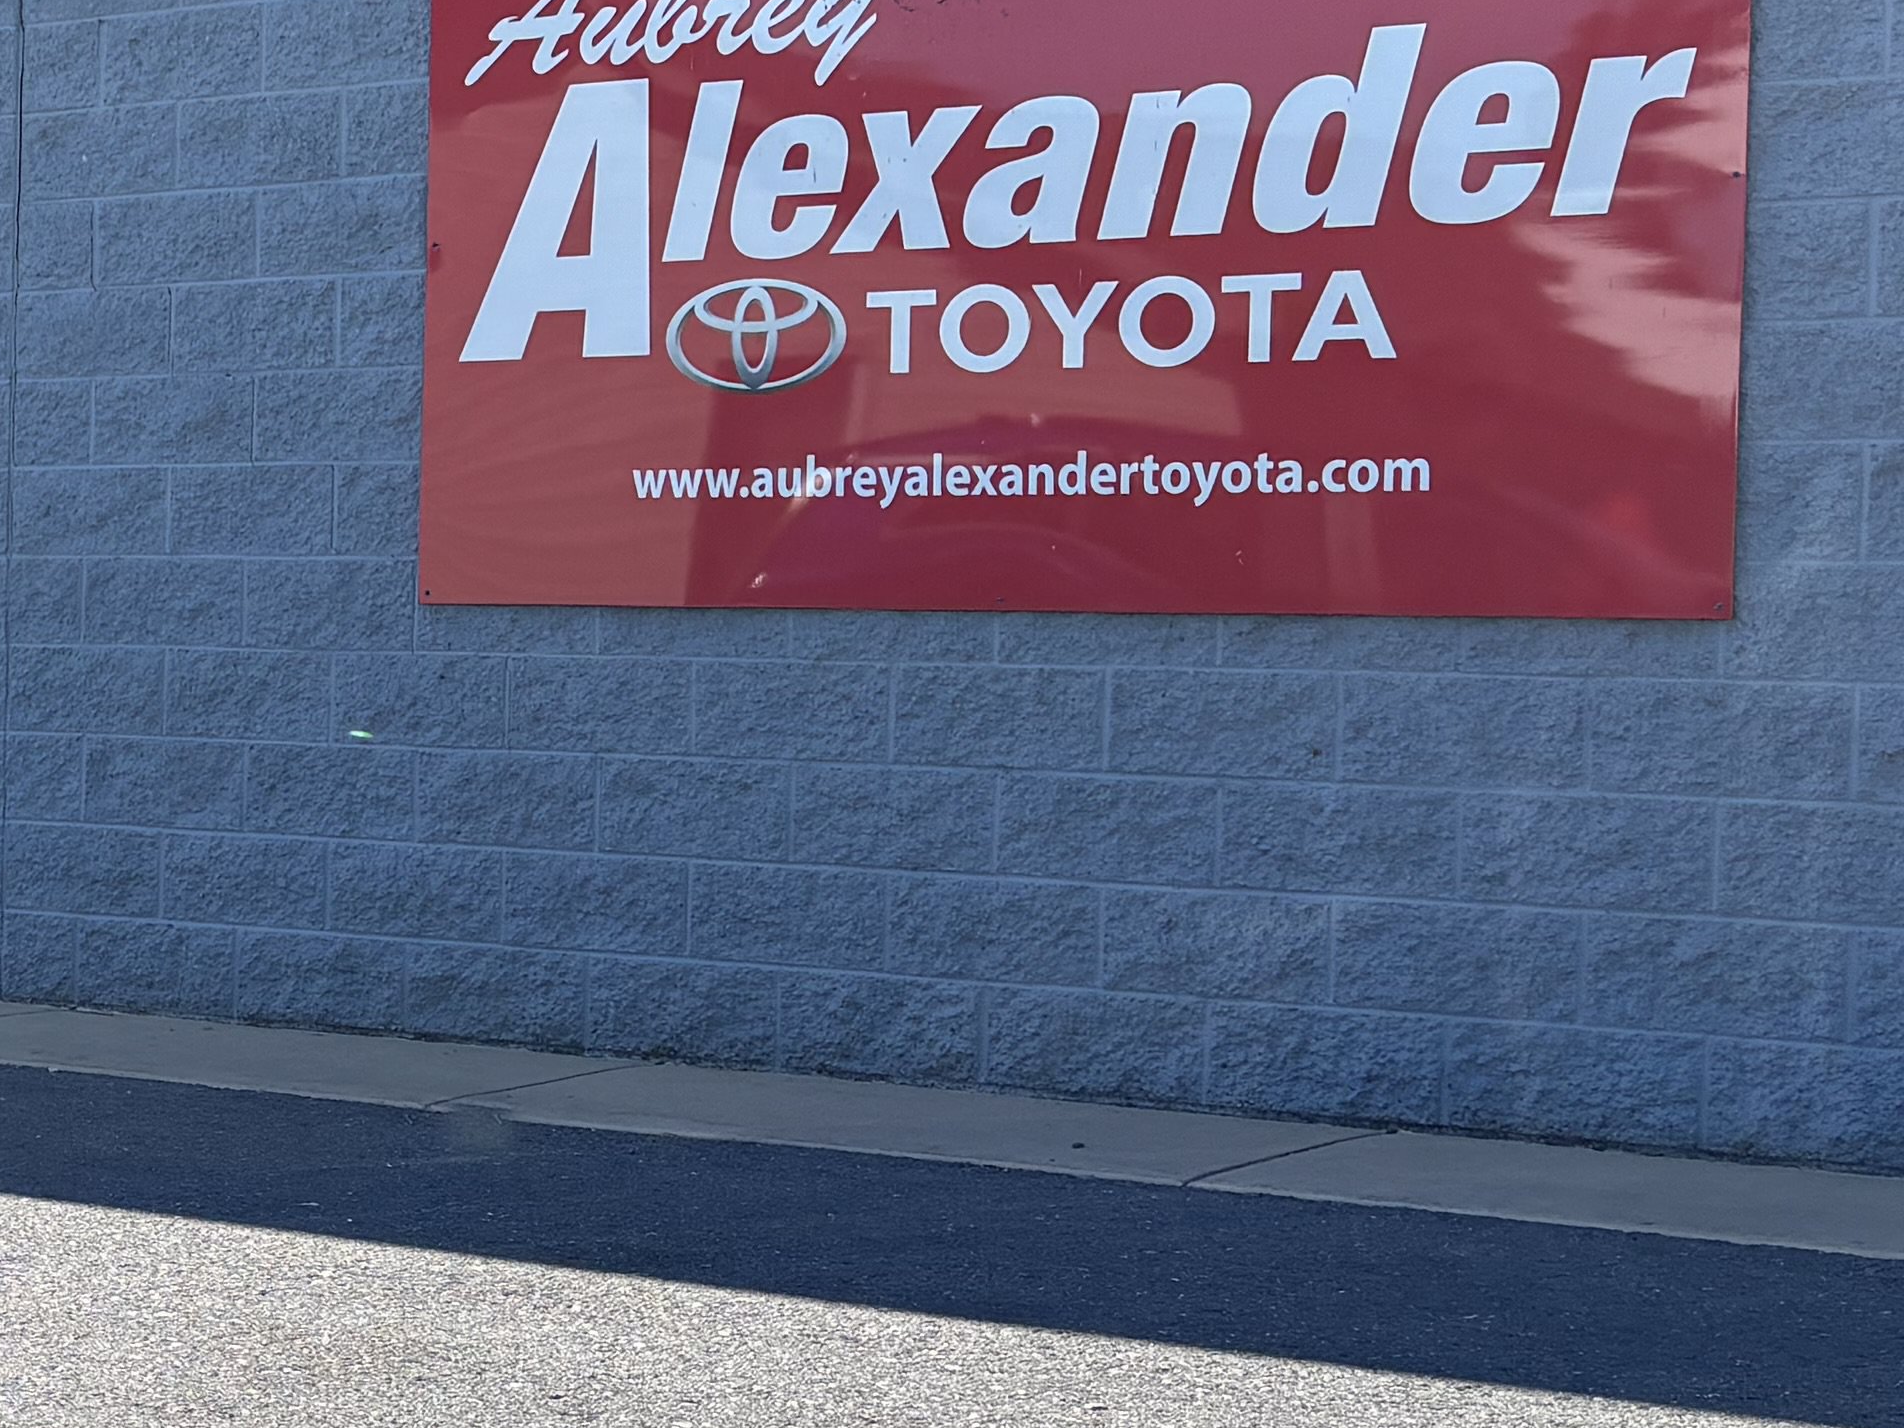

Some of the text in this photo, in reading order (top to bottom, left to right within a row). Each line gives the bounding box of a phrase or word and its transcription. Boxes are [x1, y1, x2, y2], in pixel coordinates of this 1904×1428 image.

[458, 22, 1698, 364] Alexander
[865, 269, 1397, 374] TOYOTA
[631, 449, 1431, 510] www.aubreyalexandertoyota.com
